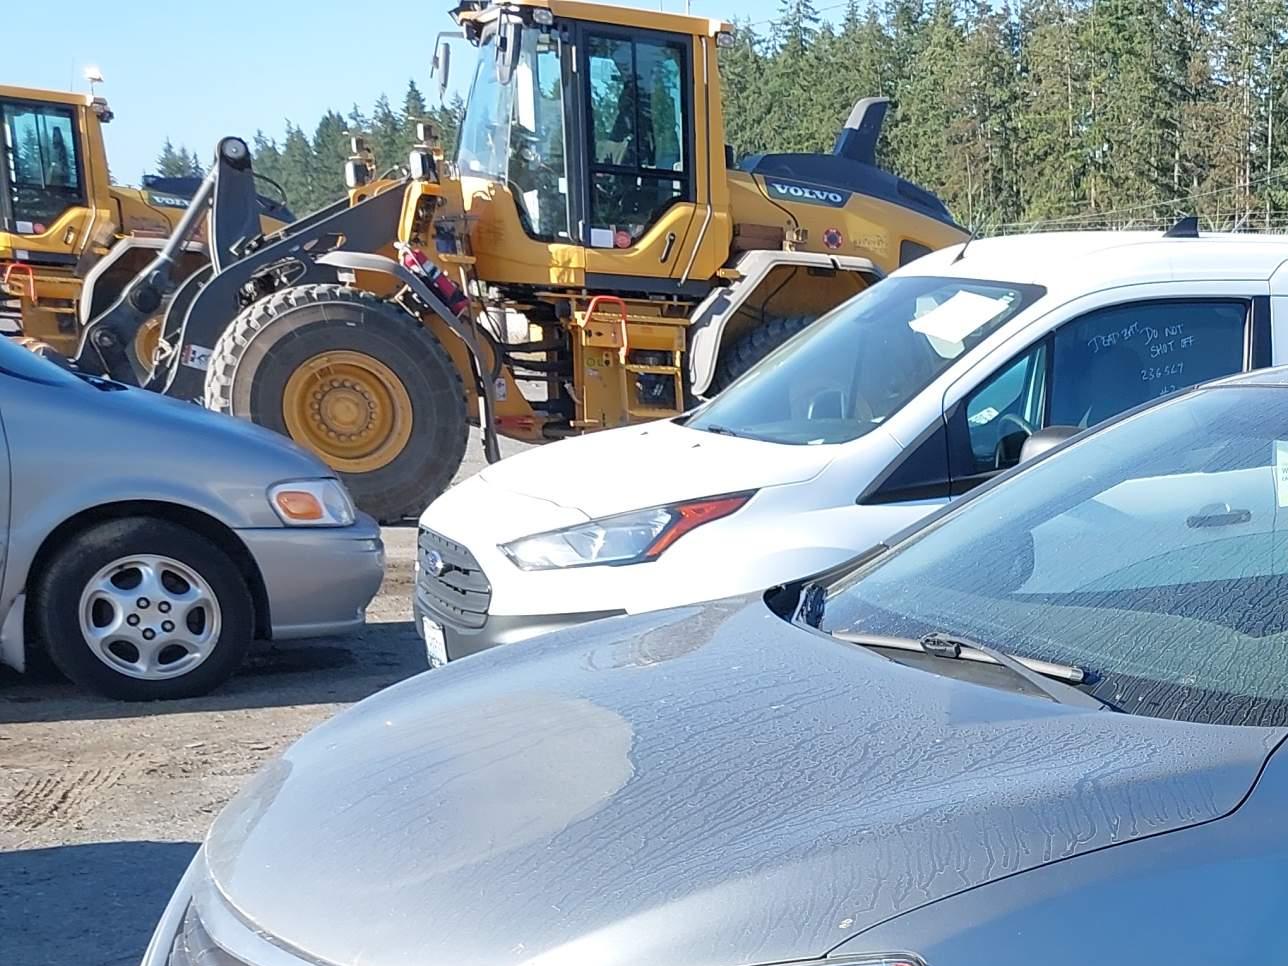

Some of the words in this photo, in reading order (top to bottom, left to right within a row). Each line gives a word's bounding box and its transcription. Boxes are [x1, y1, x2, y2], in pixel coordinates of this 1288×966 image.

[772, 183, 842, 202] VOLVO
[152, 195, 190, 207] VOLV
[1165, 324, 1183, 337] NOT
